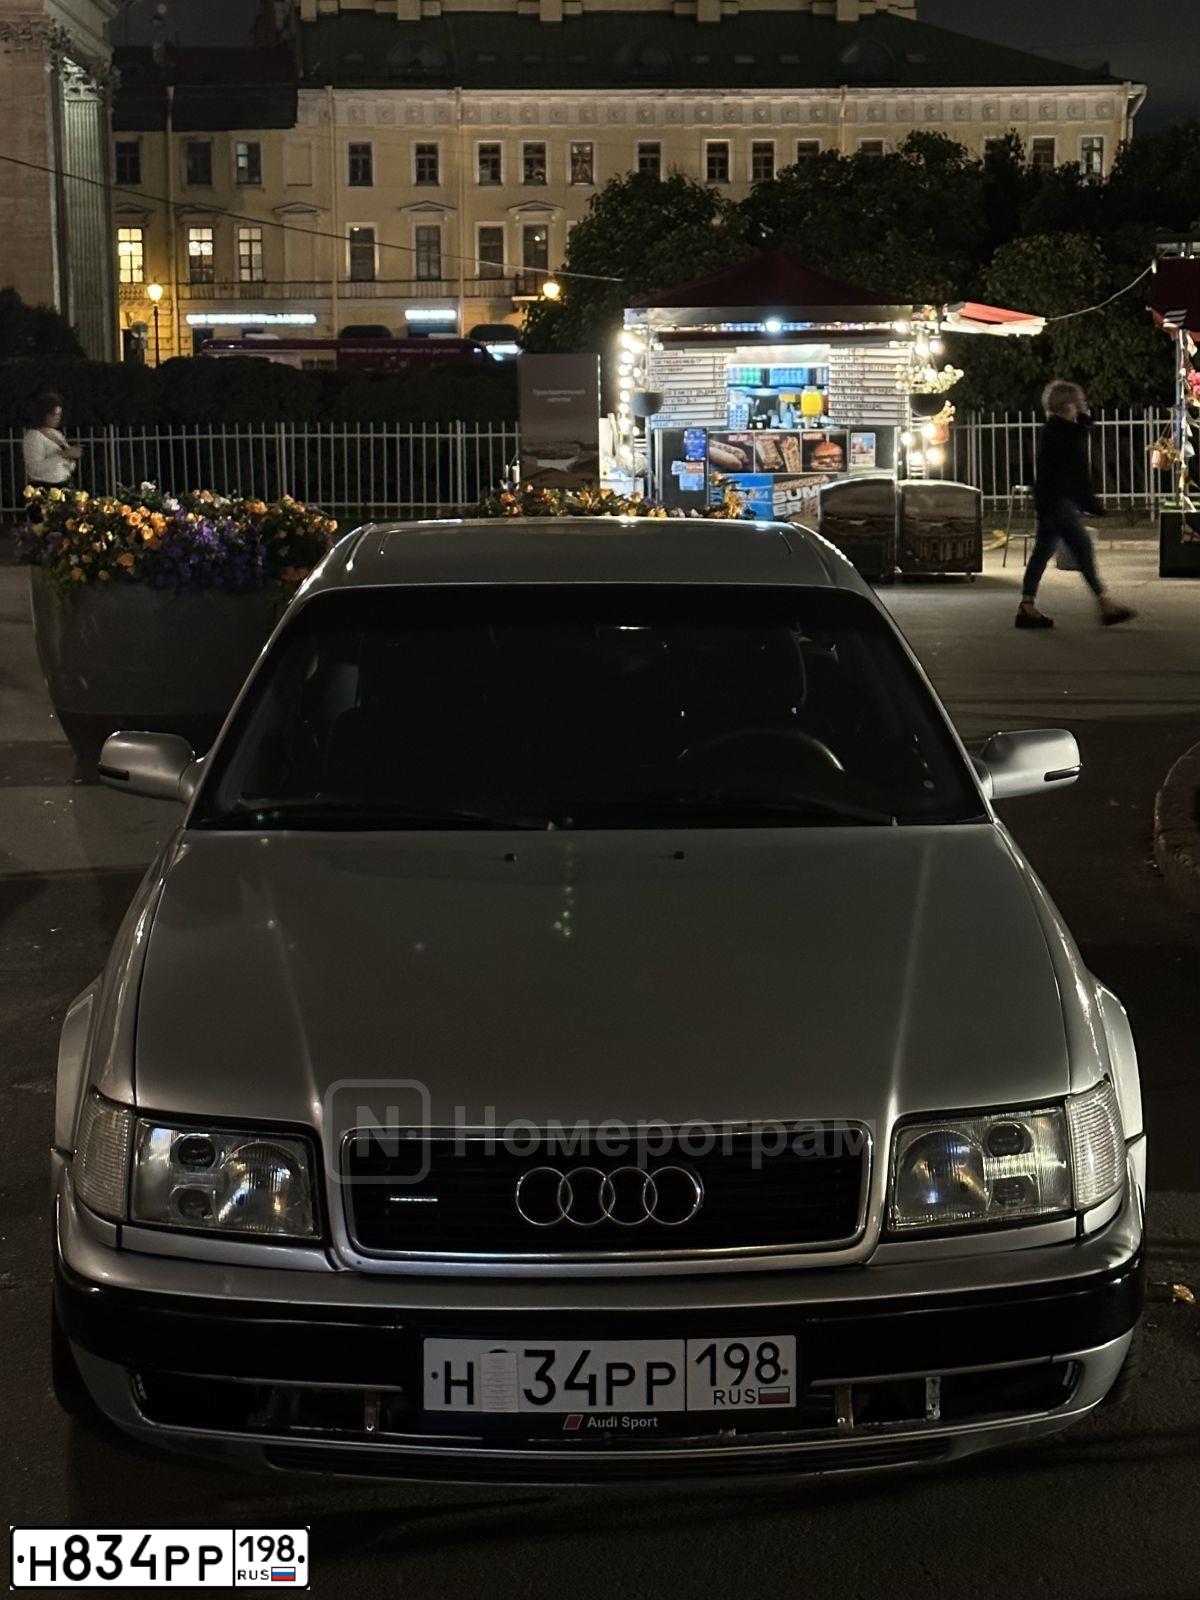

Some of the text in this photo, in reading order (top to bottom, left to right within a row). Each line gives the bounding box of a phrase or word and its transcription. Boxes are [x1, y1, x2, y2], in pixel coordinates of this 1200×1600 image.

[444, 1349, 676, 1406] Н34РР
[695, 1342, 781, 1387] 198
[713, 1389, 756, 1404] RUS
[587, 1416, 658, 1430] Audi Sport
